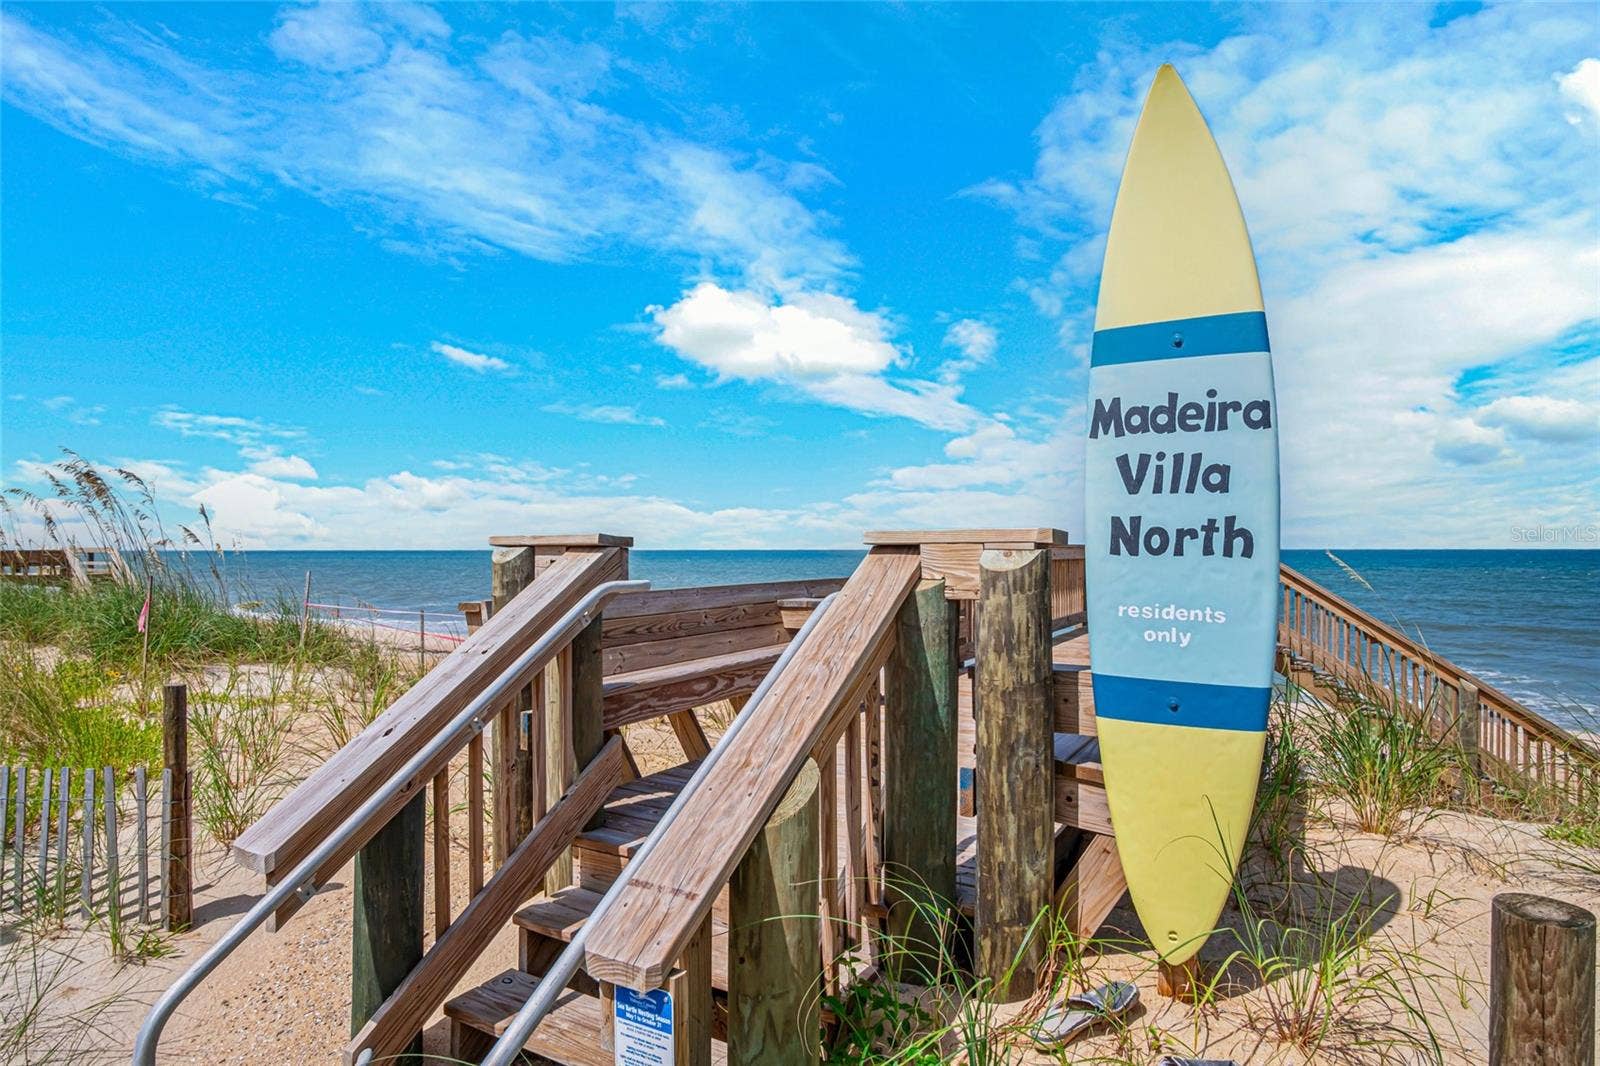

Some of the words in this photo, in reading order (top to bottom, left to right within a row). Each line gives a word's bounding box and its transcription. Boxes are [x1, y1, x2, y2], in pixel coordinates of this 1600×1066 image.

[1089, 388, 1272, 439] Madeira
[1116, 451, 1231, 495] Villa
[1109, 515, 1255, 559] North
[1118, 603, 1227, 624] residents
[1143, 627, 1192, 648] only
[637, 1008, 655, 1021] Nesting
